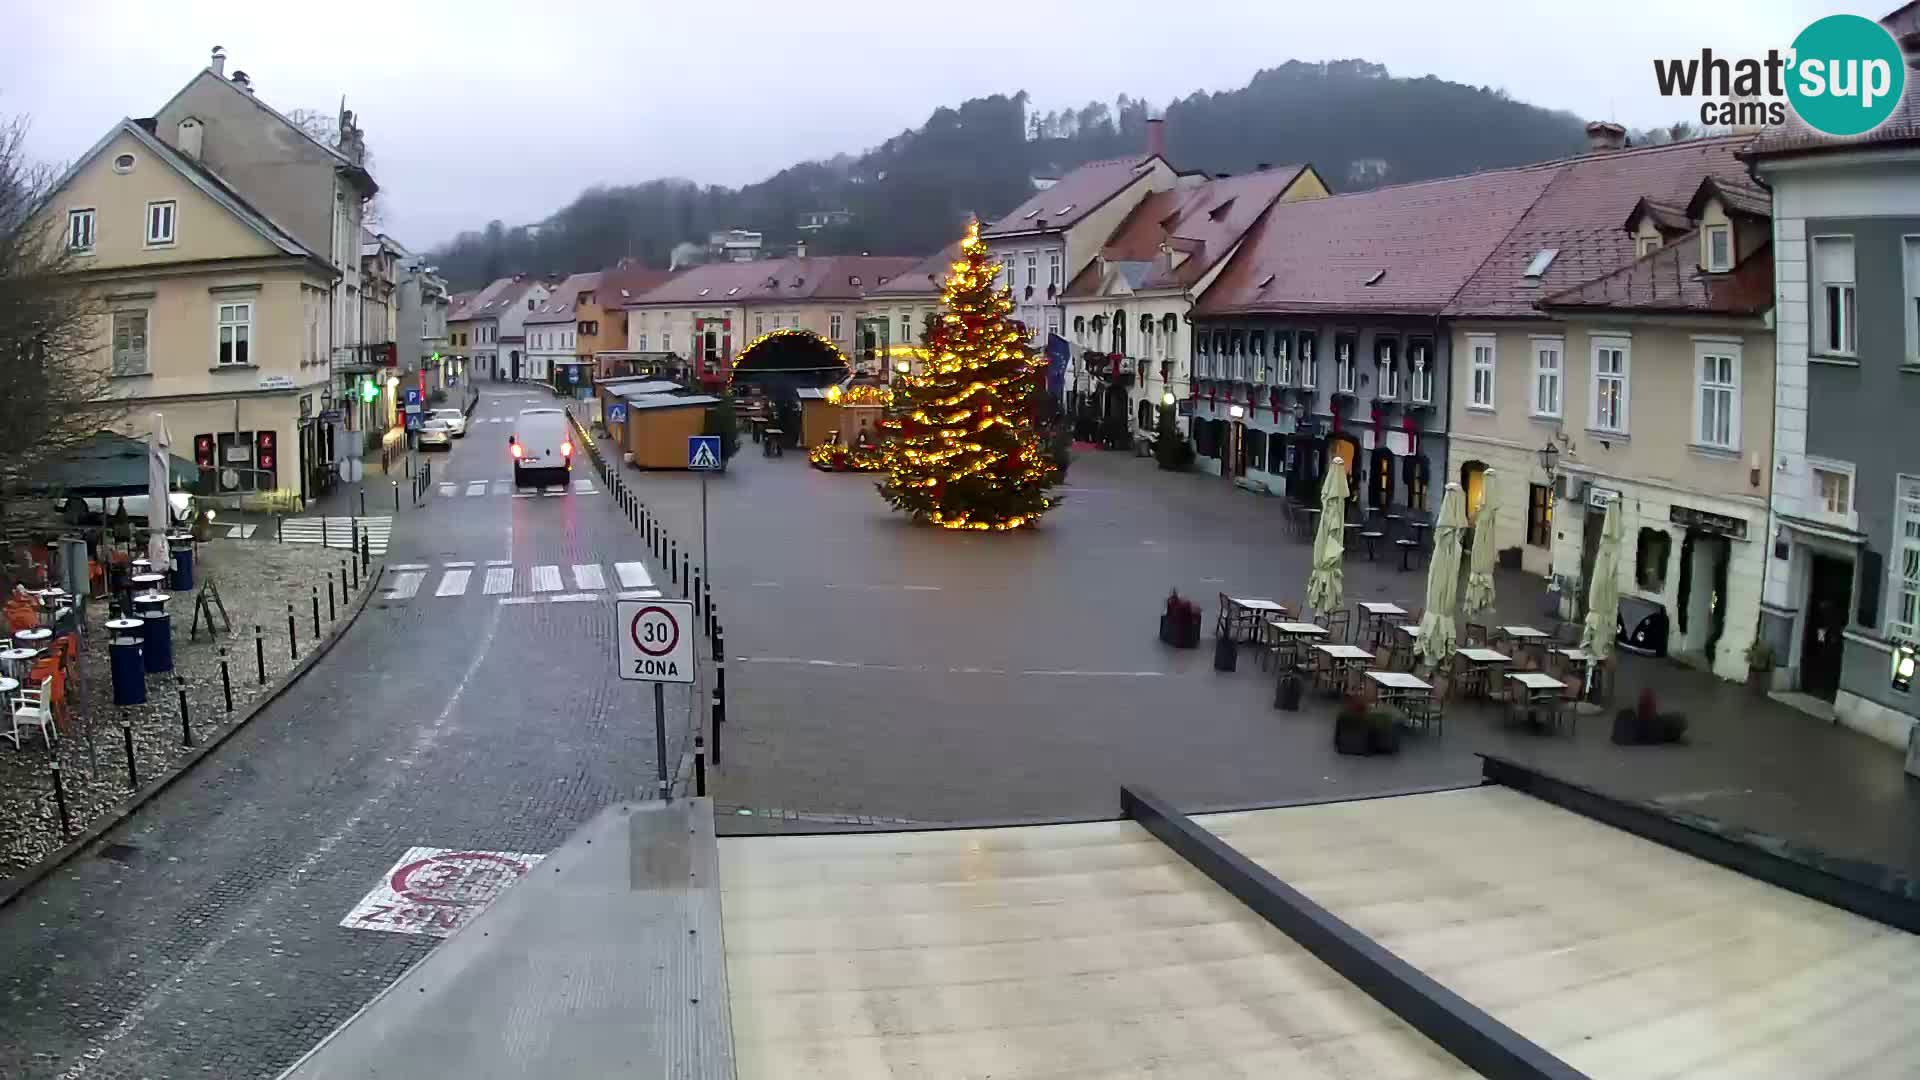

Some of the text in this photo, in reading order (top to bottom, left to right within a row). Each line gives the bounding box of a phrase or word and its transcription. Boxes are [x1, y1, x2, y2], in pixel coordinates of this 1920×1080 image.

[409, 391, 417, 402] P
[644, 622, 668, 643] 30
[634, 659, 678, 676] ZONA
